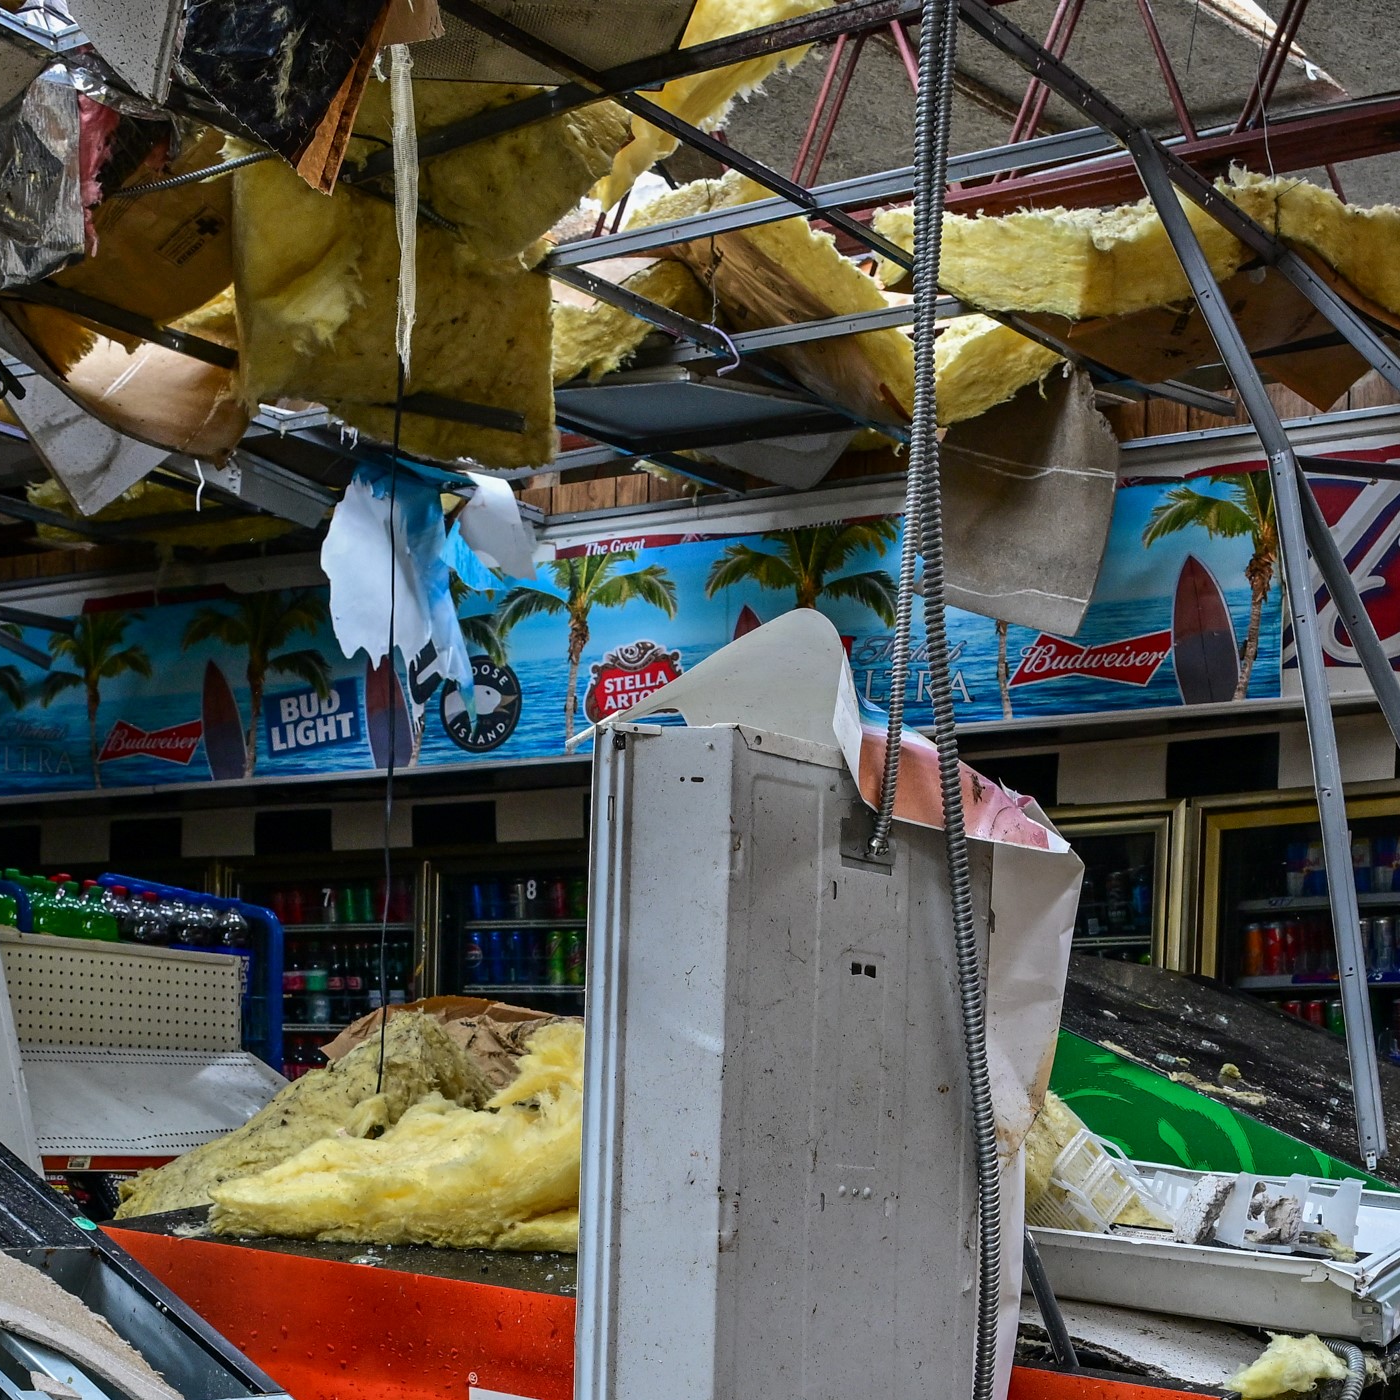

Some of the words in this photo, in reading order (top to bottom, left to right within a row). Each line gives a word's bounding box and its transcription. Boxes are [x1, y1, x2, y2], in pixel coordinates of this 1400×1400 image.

[584, 542, 608, 557] The
[609, 538, 647, 553] Great
[1019, 643, 1167, 674] Budweiser
[471, 663, 509, 688] OOSE
[603, 670, 669, 694] STELLA
[280, 689, 341, 724] BUD
[603, 688, 662, 711] ARTO
[103, 725, 202, 753] Budweiser
[270, 711, 354, 752] LIGHT
[452, 721, 507, 746] ISLAND
[321, 887, 332, 908] 7
[525, 879, 538, 901] 8
